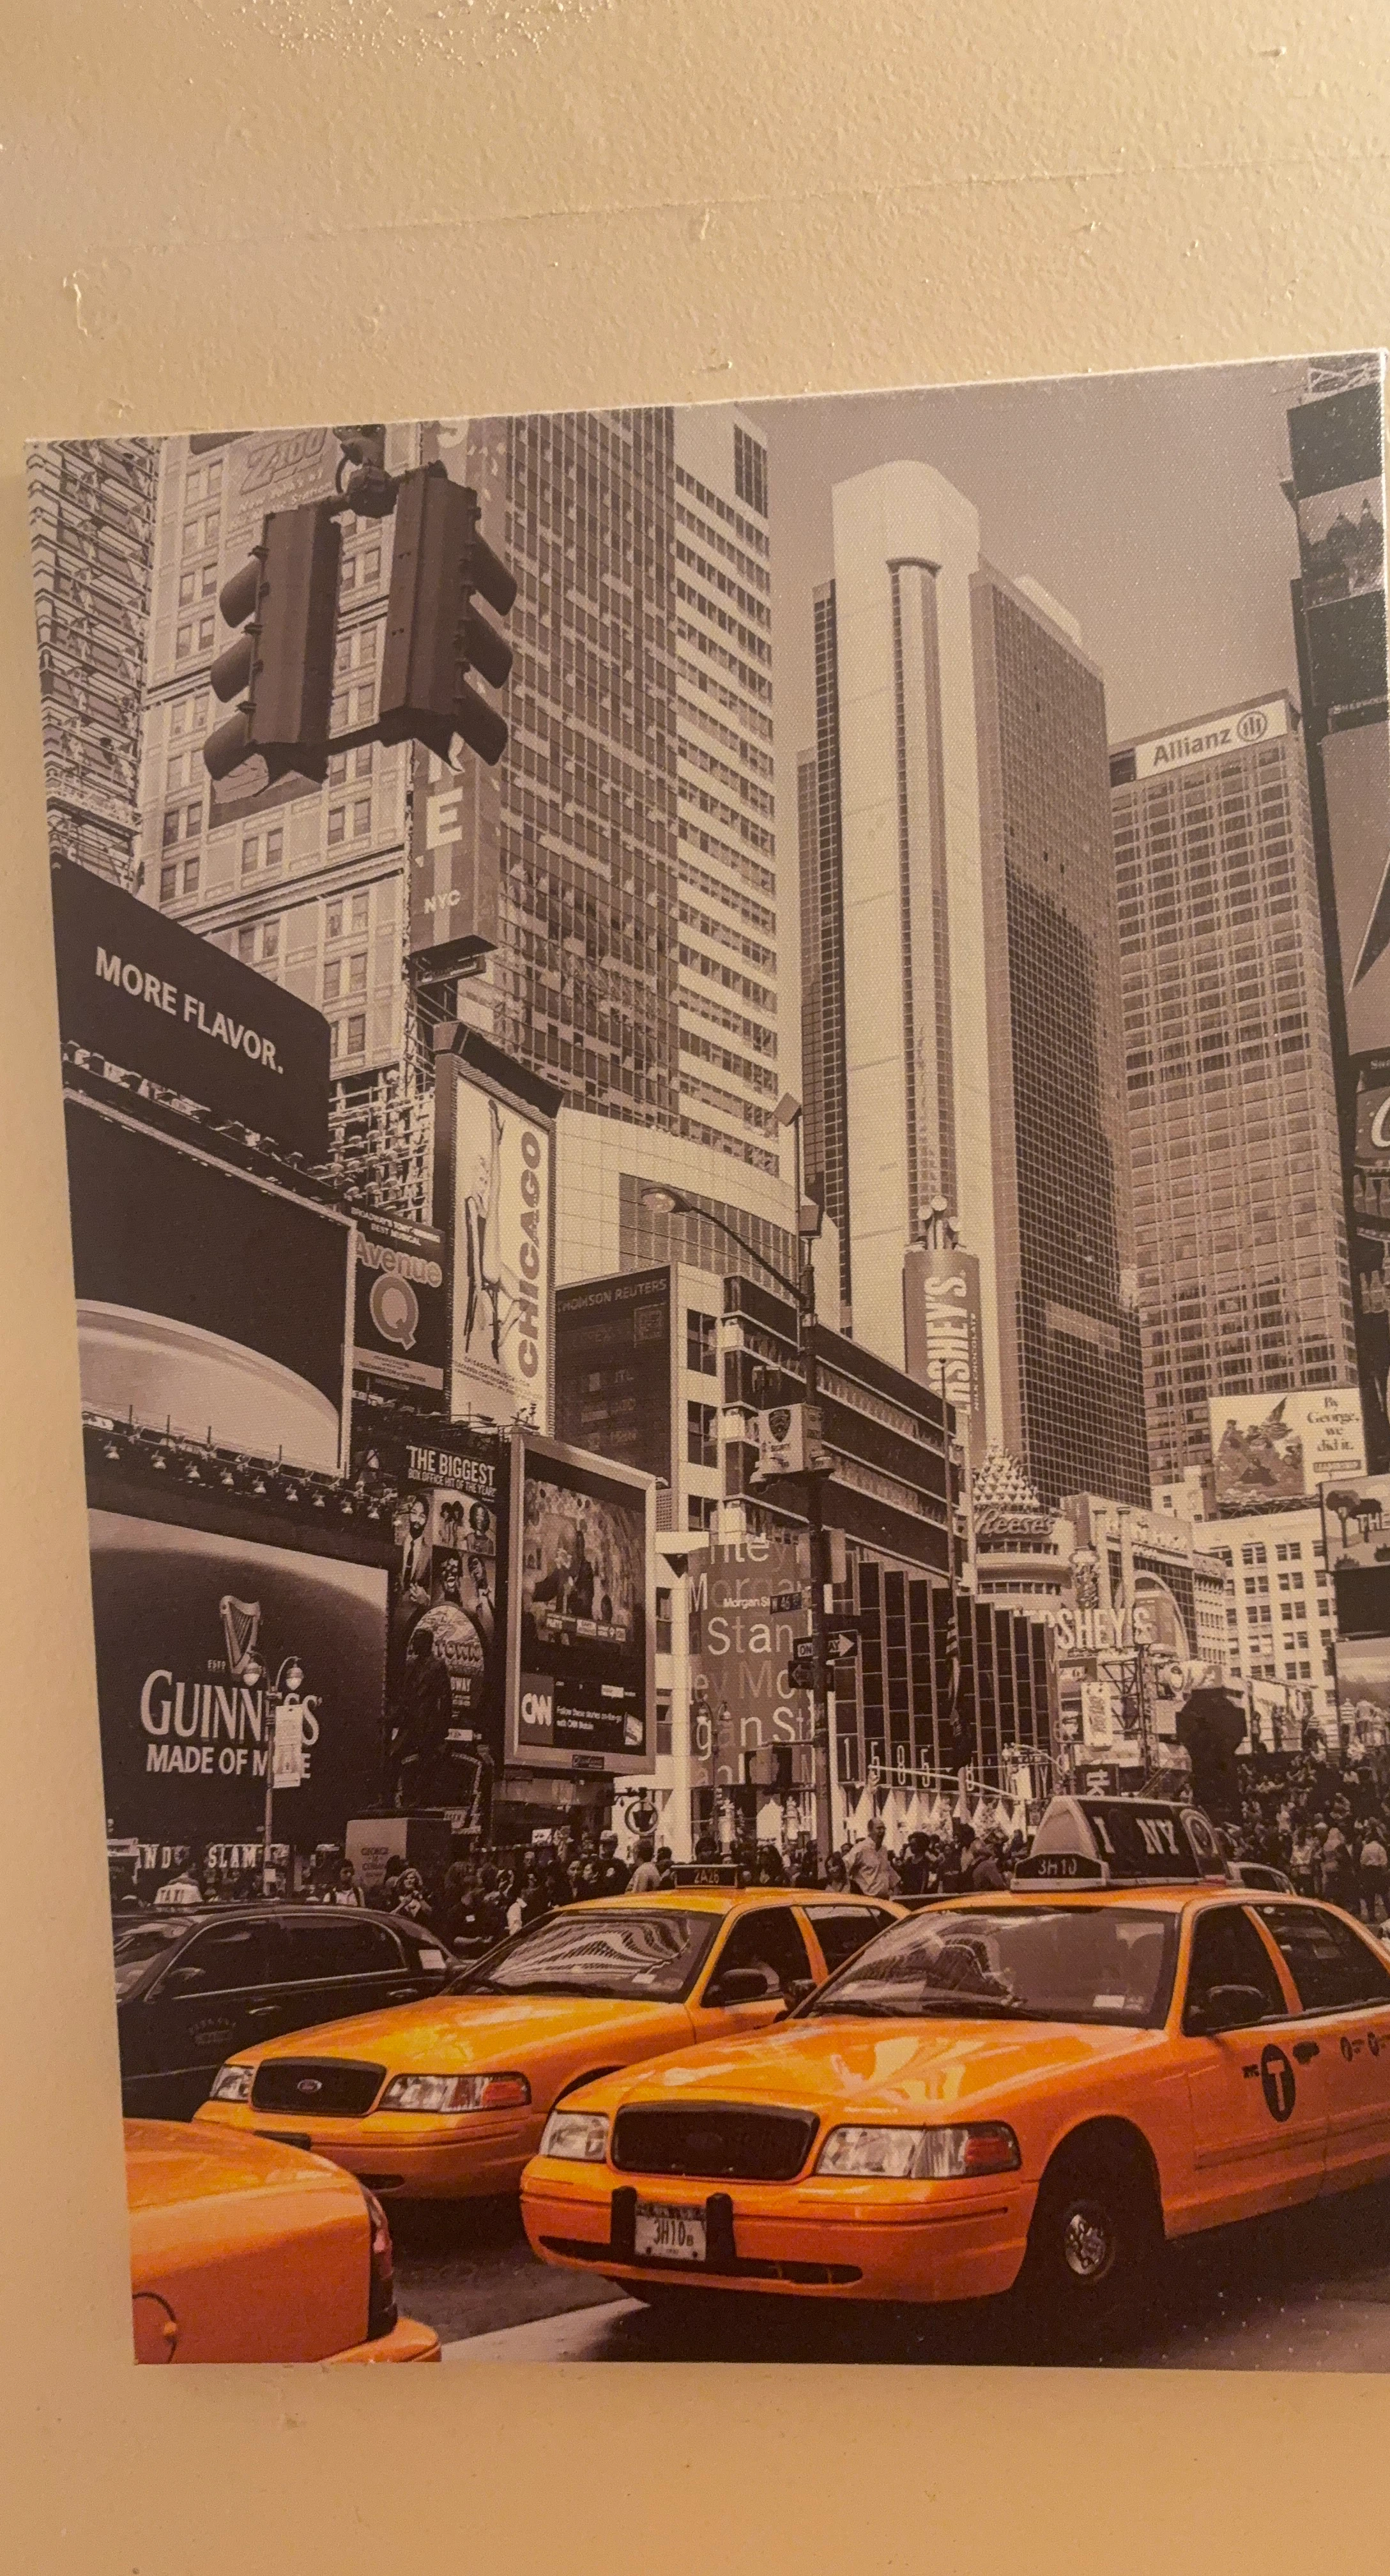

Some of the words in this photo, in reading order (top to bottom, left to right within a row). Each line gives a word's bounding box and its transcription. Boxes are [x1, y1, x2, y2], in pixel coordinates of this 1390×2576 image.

[1153, 728, 1231, 766] Allianz
[424, 889, 461, 914] NYC
[96, 946, 178, 1015] MORE
[184, 993, 284, 1074] FLAVOR.
[356, 1230, 442, 1288] Avenue
[518, 1131, 540, 1377] CHICAGO
[615, 1278, 668, 1301] REUTERS
[370, 1273, 419, 1351] Q
[406, 1445, 436, 1473] THE
[439, 1453, 496, 1487] BIGGEST
[422, 1472, 444, 1486] OFFICE
[455, 1479, 464, 1489] OF
[722, 1597, 760, 1609] Morgan
[800, 1644, 813, 1655] ON
[140, 1669, 319, 1745] GUINNS
[521, 1692, 553, 1726] CNN
[146, 1744, 215, 1774] MADE
[218, 1748, 248, 1775] OF
[252, 1750, 311, 1779] ME
[843, 1737, 931, 1788] 1585
[1135, 1818, 1180, 1854] NY
[1037, 1857, 1078, 1876] 3H10
